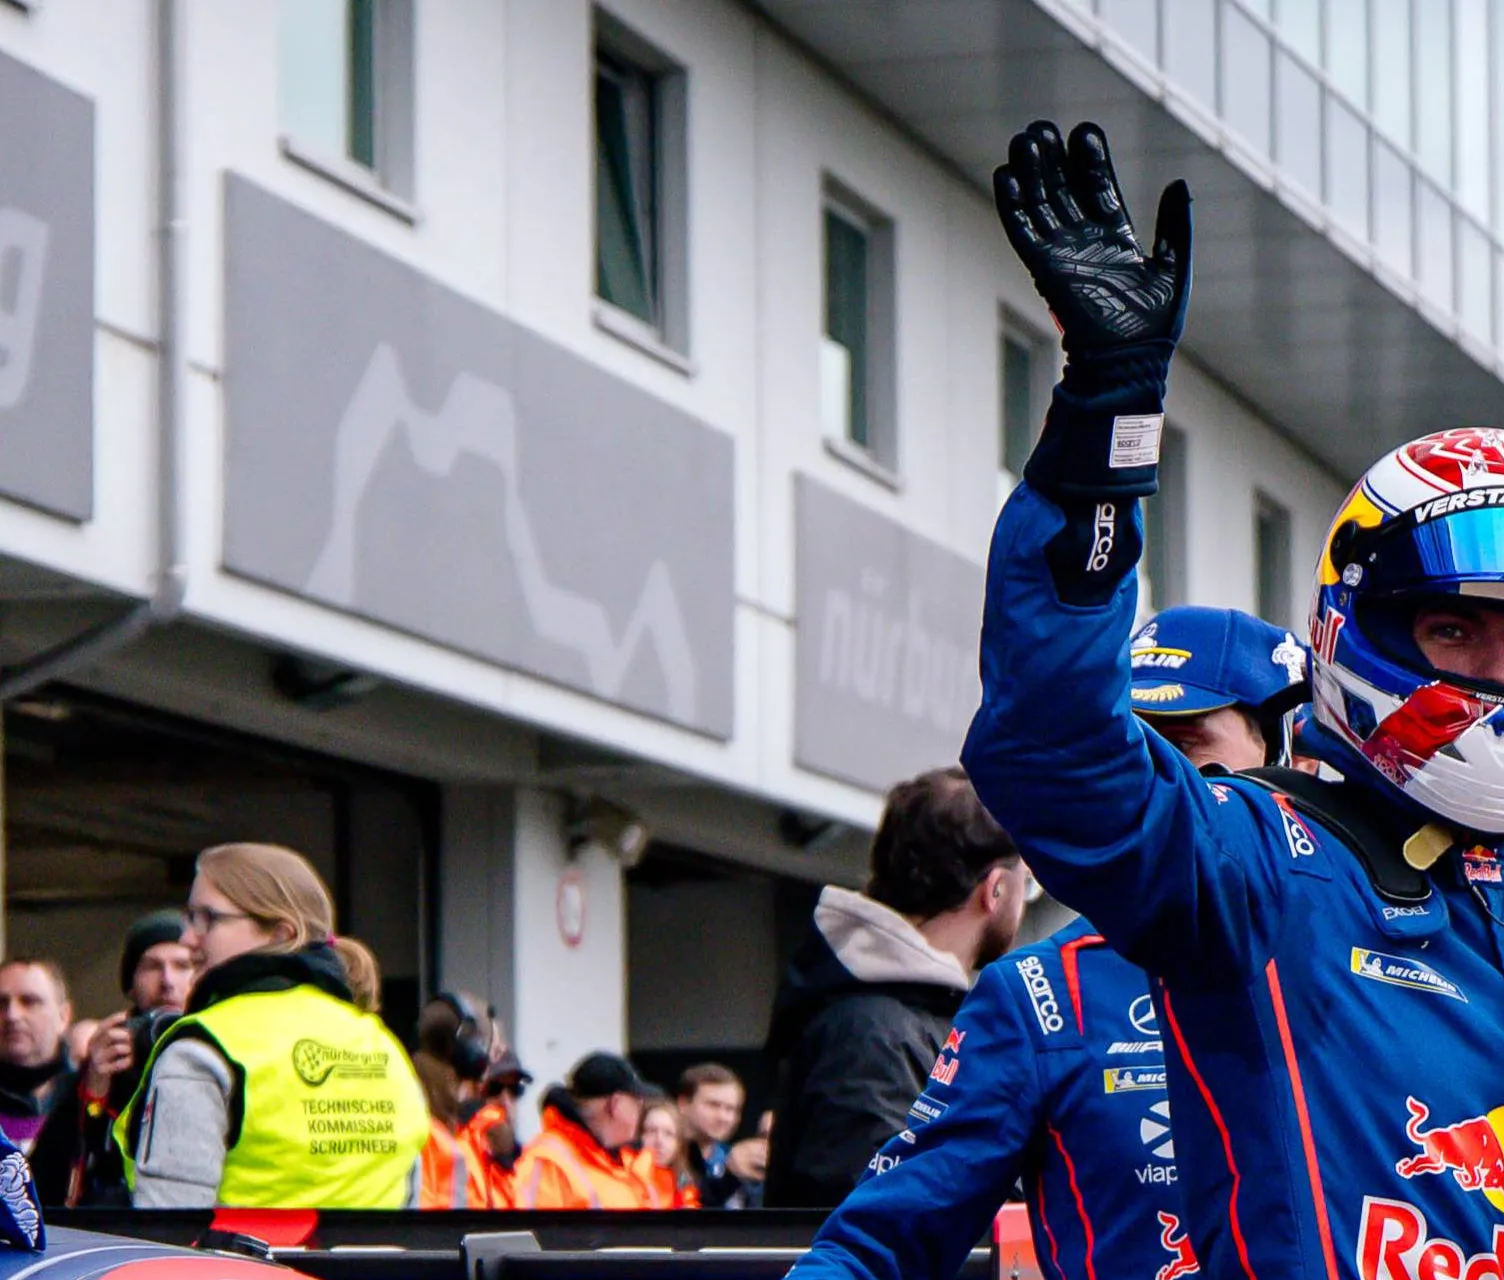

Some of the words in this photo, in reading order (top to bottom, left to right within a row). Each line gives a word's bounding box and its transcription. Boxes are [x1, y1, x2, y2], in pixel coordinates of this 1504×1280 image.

[1018, 956, 1064, 1034] sparco
[301, 1100, 396, 1115] TECHNISCHER
[308, 1119, 395, 1134] KOMMISSAR
[310, 1139, 398, 1155] SCRUTINEER
